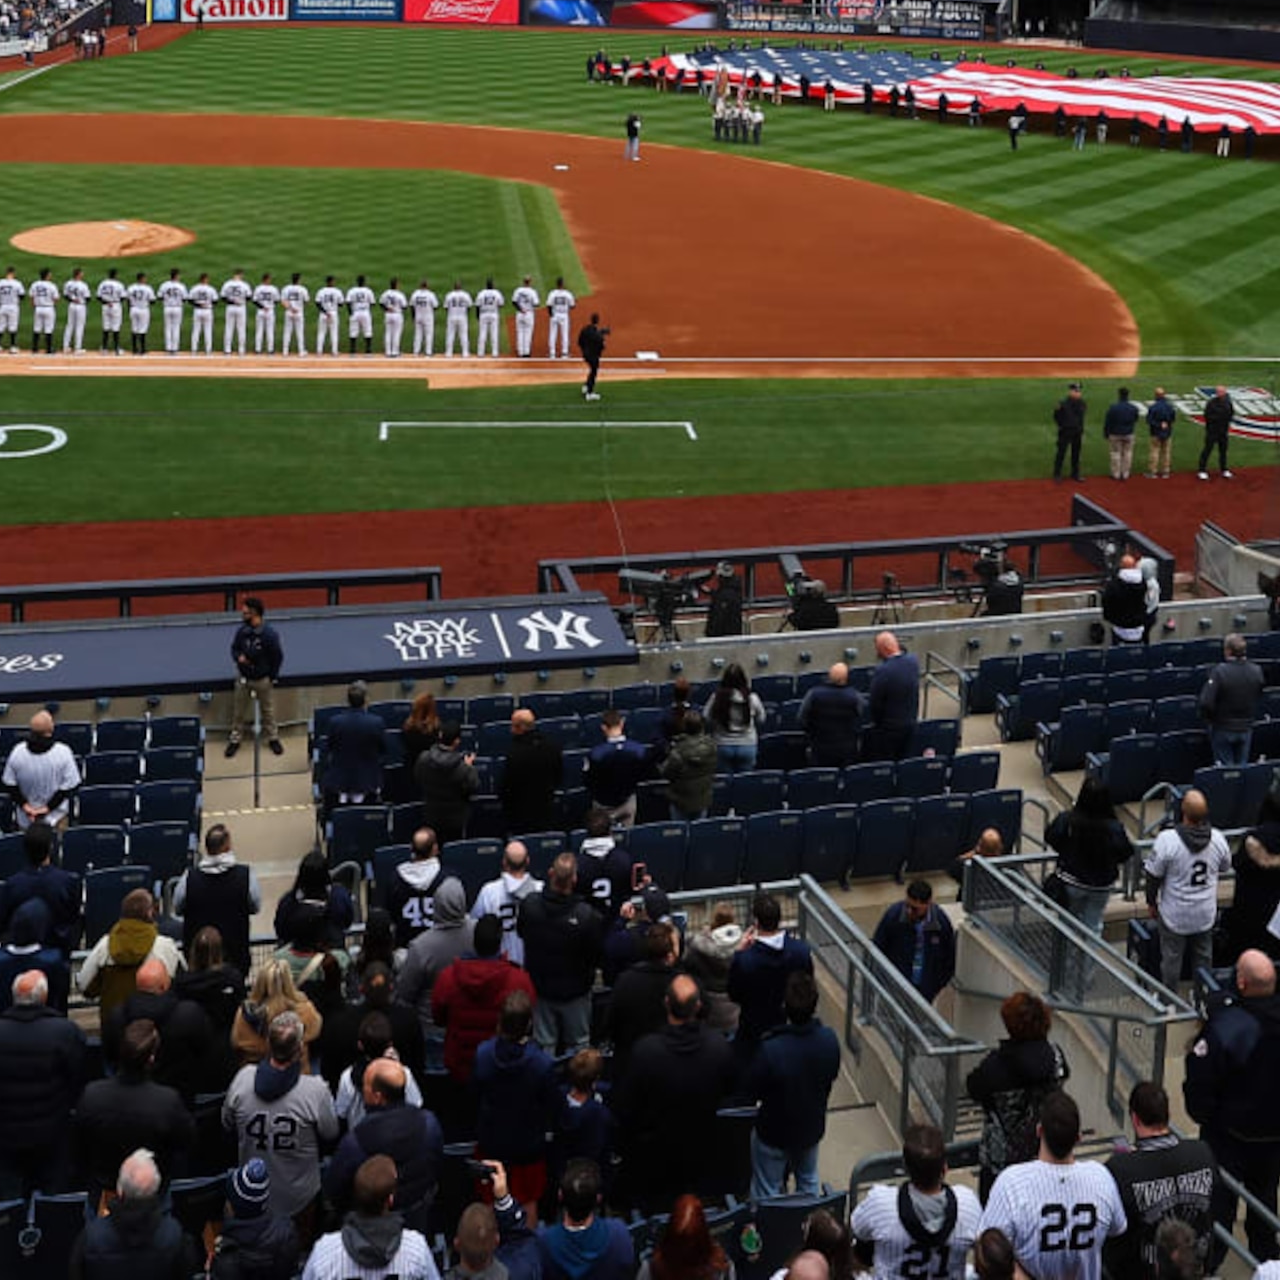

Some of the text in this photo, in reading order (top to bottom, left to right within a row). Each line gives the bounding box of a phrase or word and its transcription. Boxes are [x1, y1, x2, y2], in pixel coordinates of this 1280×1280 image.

[394, 617, 468, 635] NEW
[384, 628, 484, 649] YORK
[400, 644, 476, 662] LIFE
[1190, 860, 1208, 887] 2
[246, 1113, 298, 1151] 42
[1040, 1203, 1097, 1253] 22
